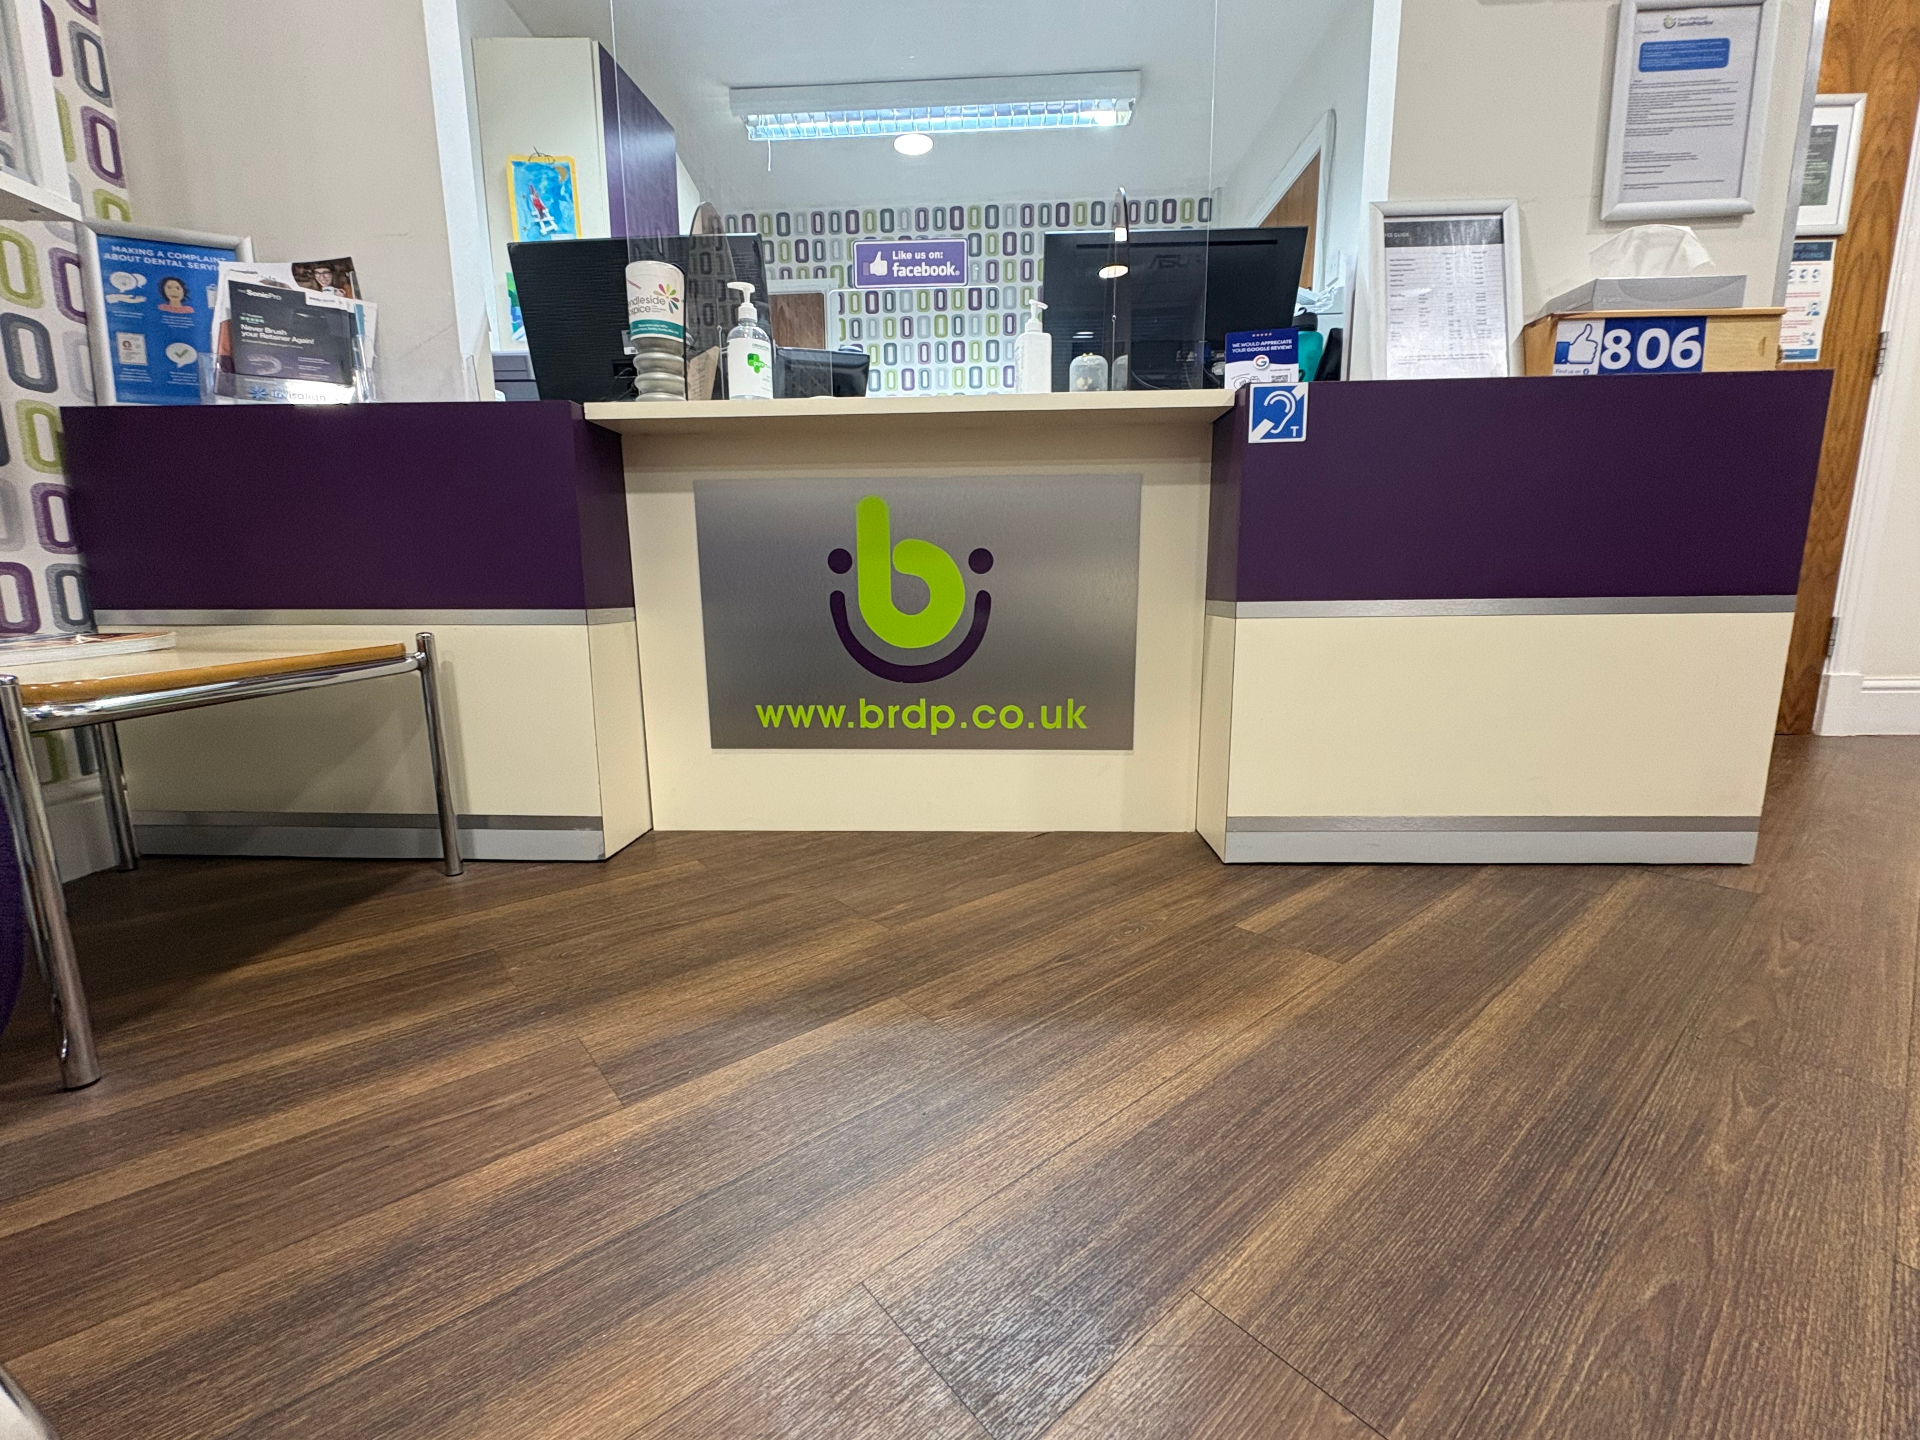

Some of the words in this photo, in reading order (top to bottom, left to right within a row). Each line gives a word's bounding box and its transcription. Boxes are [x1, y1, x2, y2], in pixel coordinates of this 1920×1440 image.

[111, 245, 154, 257] MAKING
[892, 250, 913, 260] Like
[915, 251, 926, 260] us
[928, 251, 944, 259] on:
[103, 253, 141, 263] ABOUT
[143, 257, 186, 269] DENTAL
[245, 288, 282, 301] SonicPro
[628, 295, 666, 307] ndleside
[629, 304, 651, 316] spice
[240, 323, 264, 333] Never
[264, 327, 288, 336] Brush
[240, 330, 259, 338] your
[260, 332, 291, 342] Retainer
[291, 335, 315, 345] Again!
[1260, 338, 1293, 346] APPRECIATE
[1246, 345, 1270, 353] GOOGLE
[1600, 326, 1702, 370] 806
[270, 389, 327, 402] invisalign
[1290, 426, 1300, 437] T
[755, 698, 1088, 736] www.brdp.co.uk
